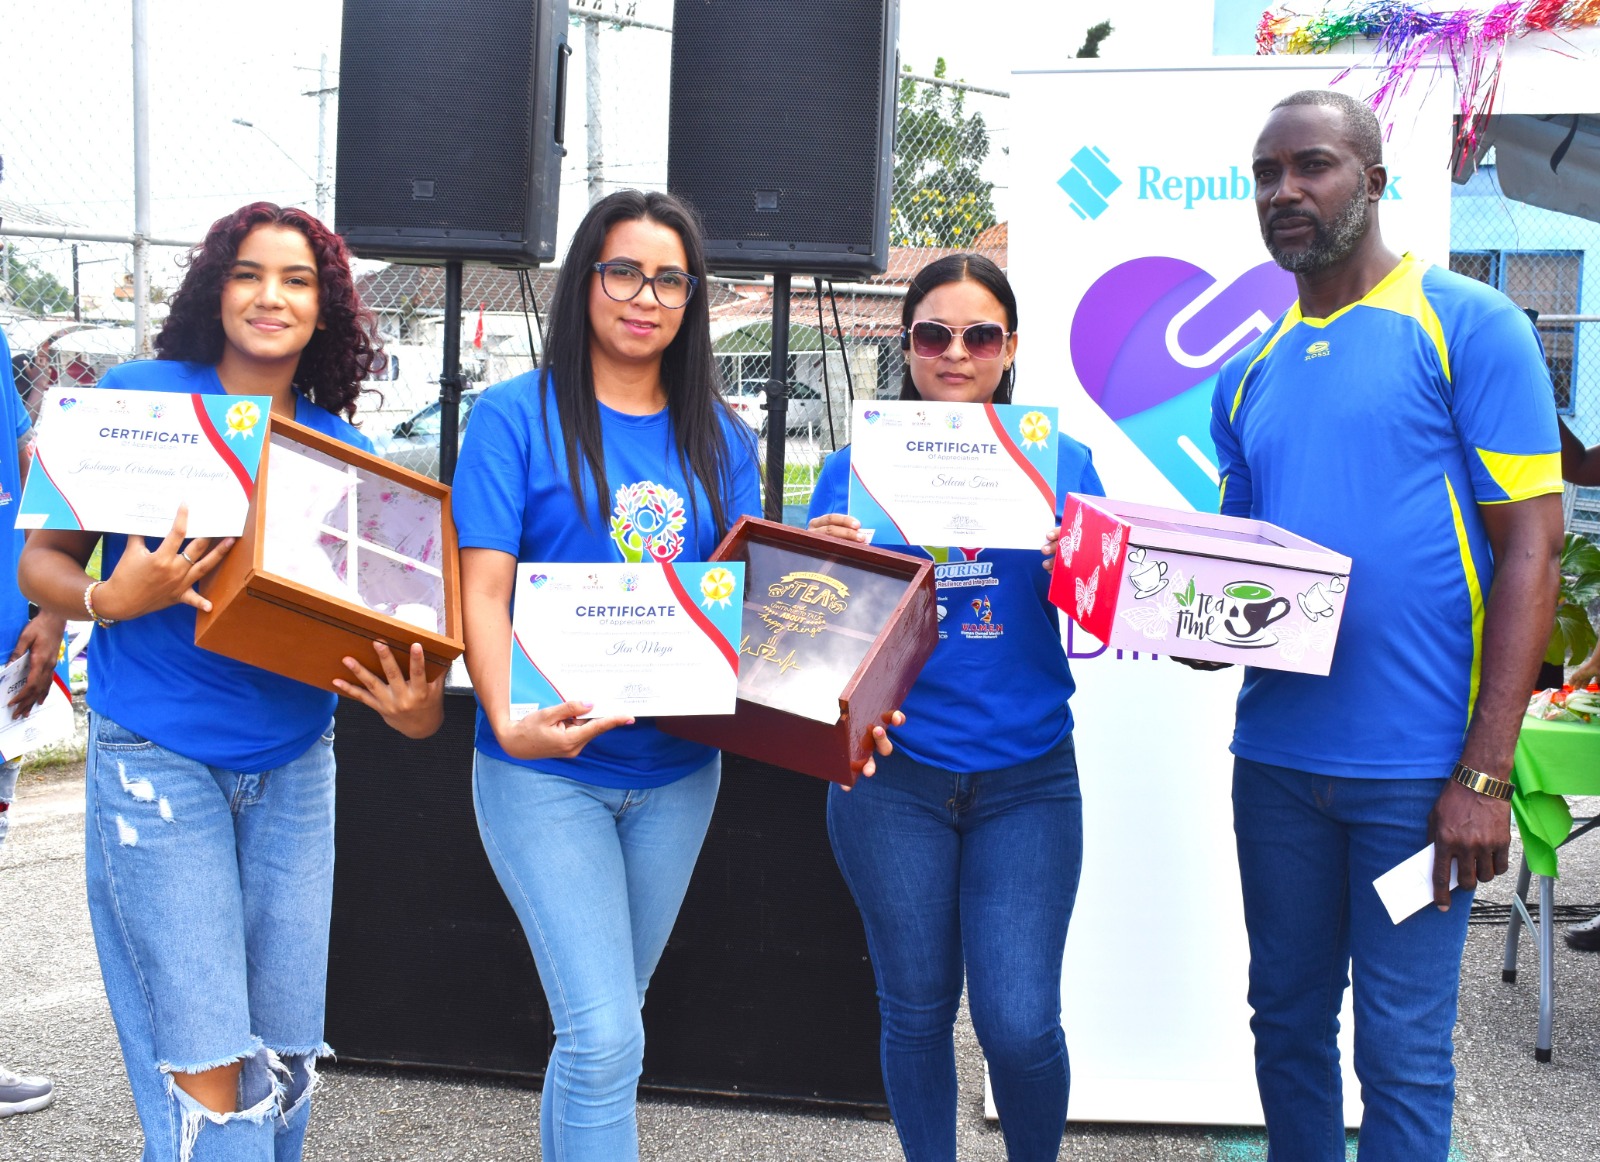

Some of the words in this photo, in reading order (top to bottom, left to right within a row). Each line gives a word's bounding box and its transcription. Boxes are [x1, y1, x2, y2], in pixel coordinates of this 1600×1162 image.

[1137, 165, 1255, 210] Repub
[99, 427, 199, 445] CERTIFICATE
[906, 441, 998, 454] CERTIFICATE
[936, 563, 993, 578] OURISH
[789, 581, 830, 607] TEA
[575, 606, 676, 617] CERTIFICATE
[1197, 593, 1225, 618] Tea
[758, 612, 785, 634] happy
[787, 622, 827, 638] things
[779, 612, 806, 623] ABOUT
[1176, 609, 1218, 640] Time
